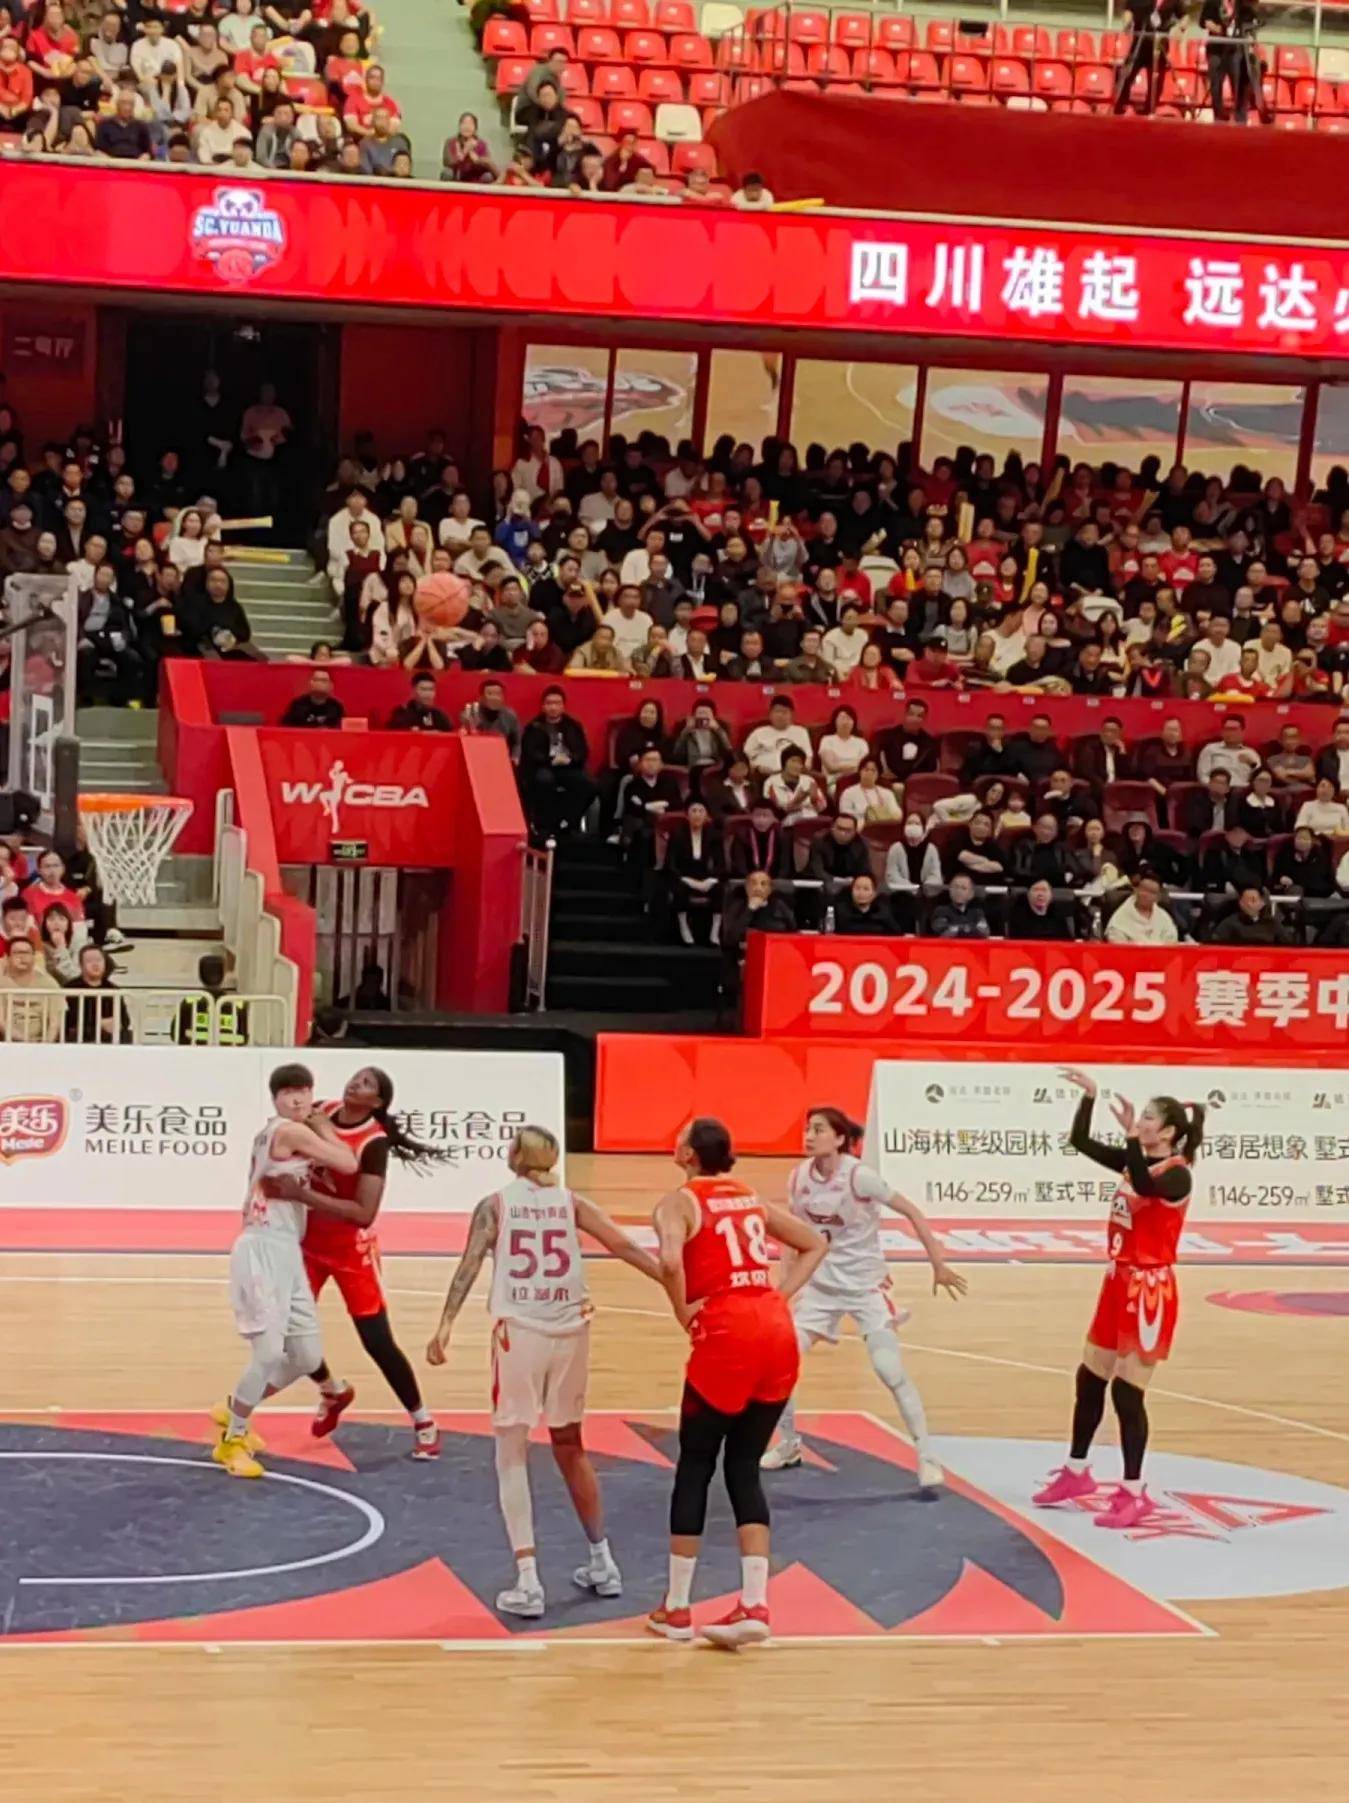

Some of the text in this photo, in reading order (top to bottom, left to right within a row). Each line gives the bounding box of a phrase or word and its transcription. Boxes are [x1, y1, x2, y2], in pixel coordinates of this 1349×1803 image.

[849, 241, 1140, 321] 四川雄起
[281, 781, 429, 808] WCBA
[808, 962, 1349, 1030] 2024-2025 赛季中
[86, 1104, 227, 1136] 美乐食品
[85, 1139, 227, 1156] MEILE FOOD
[884, 1128, 1053, 1156] 山海林墅级园林
[509, 1229, 570, 1279] 55
[714, 1214, 768, 1267] 18
